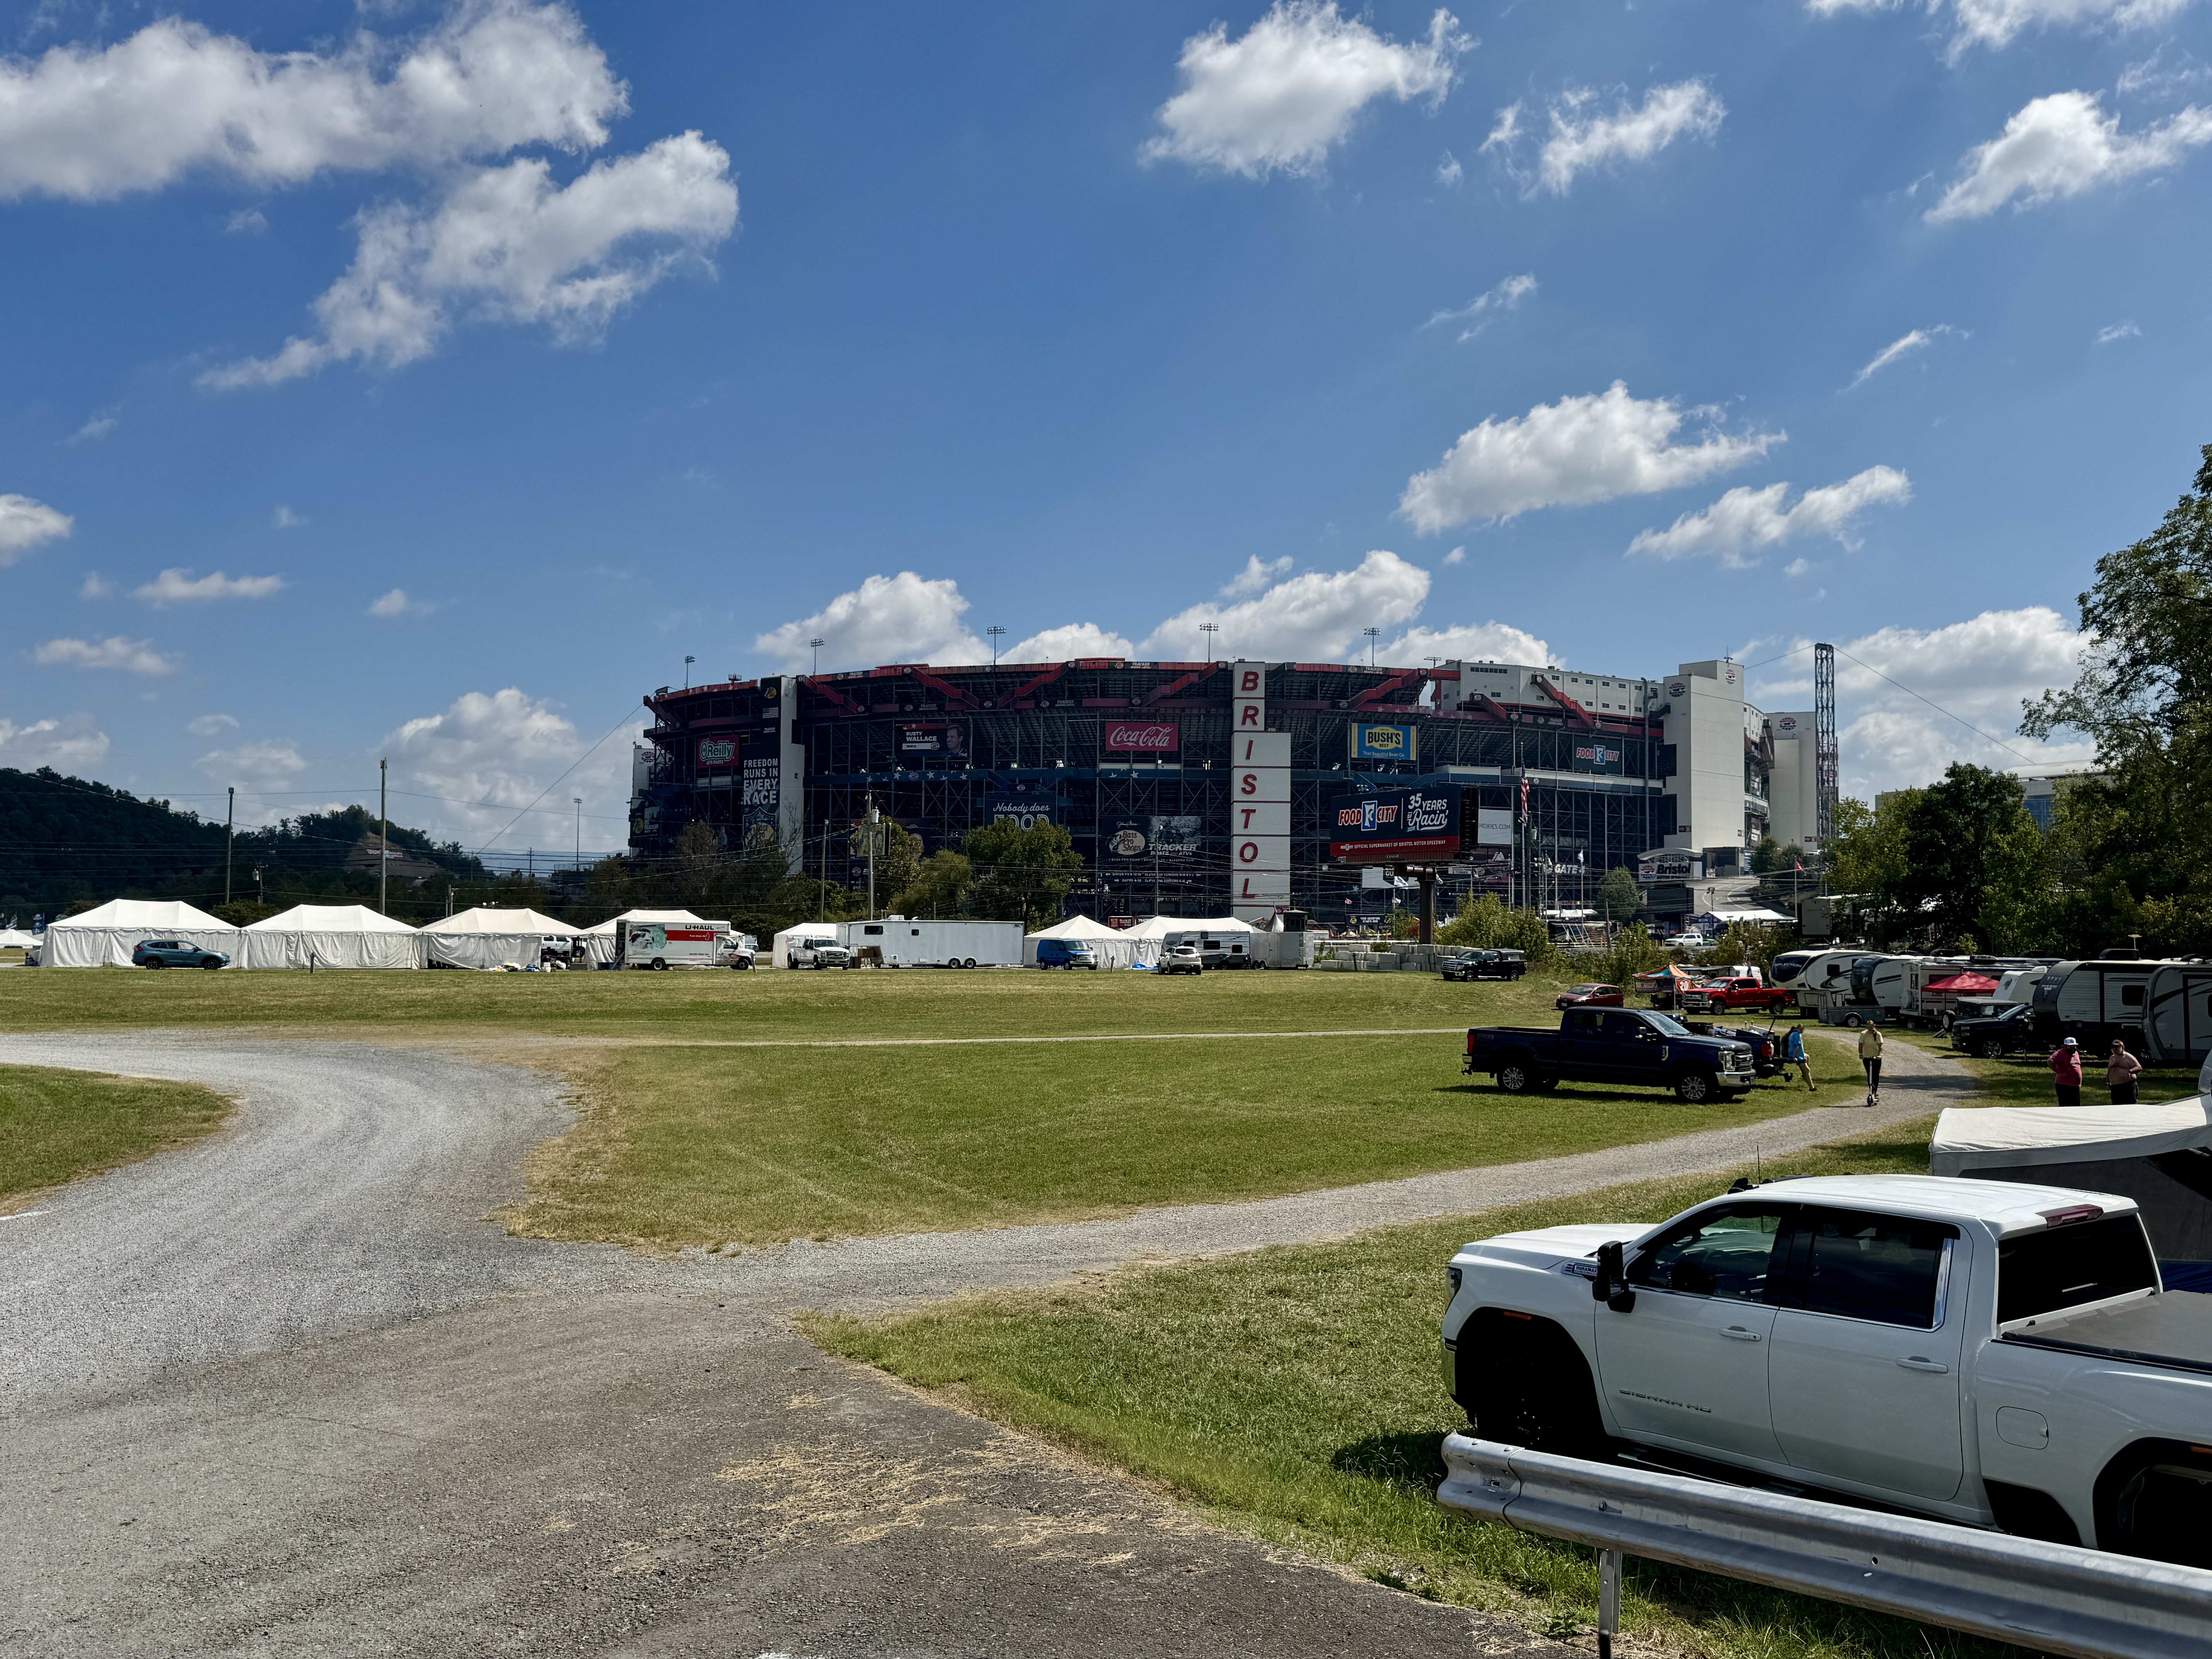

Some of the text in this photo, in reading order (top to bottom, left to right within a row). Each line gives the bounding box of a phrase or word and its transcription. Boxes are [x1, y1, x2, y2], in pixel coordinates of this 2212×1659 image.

[1110, 726, 1174, 747] Coca-Cola
[1368, 732, 1401, 745] BUSH'S
[700, 739, 735, 761] O'Reilly
[1576, 747, 1594, 759] FOOD
[1605, 750, 1620, 761] CITY
[744, 758, 778, 768] FREEDOM
[744, 768, 778, 778] RUNS IN
[744, 778, 778, 790] EVERY
[1240, 671, 1259, 898] BRISTOL
[743, 791, 777, 805] RACE
[1408, 793, 1448, 811] 35 YEARS
[993, 803, 1050, 814] Nobody does
[1338, 808, 1362, 826] FOOD
[1377, 805, 1398, 823] CITY
[1122, 844, 1141, 852] Shops
[1554, 864, 1578, 874] GATE
[1657, 863, 1691, 874] Bristol
[1680, 981, 1688, 991] 20
[1620, 1389, 1711, 1413] SIERRA HD
